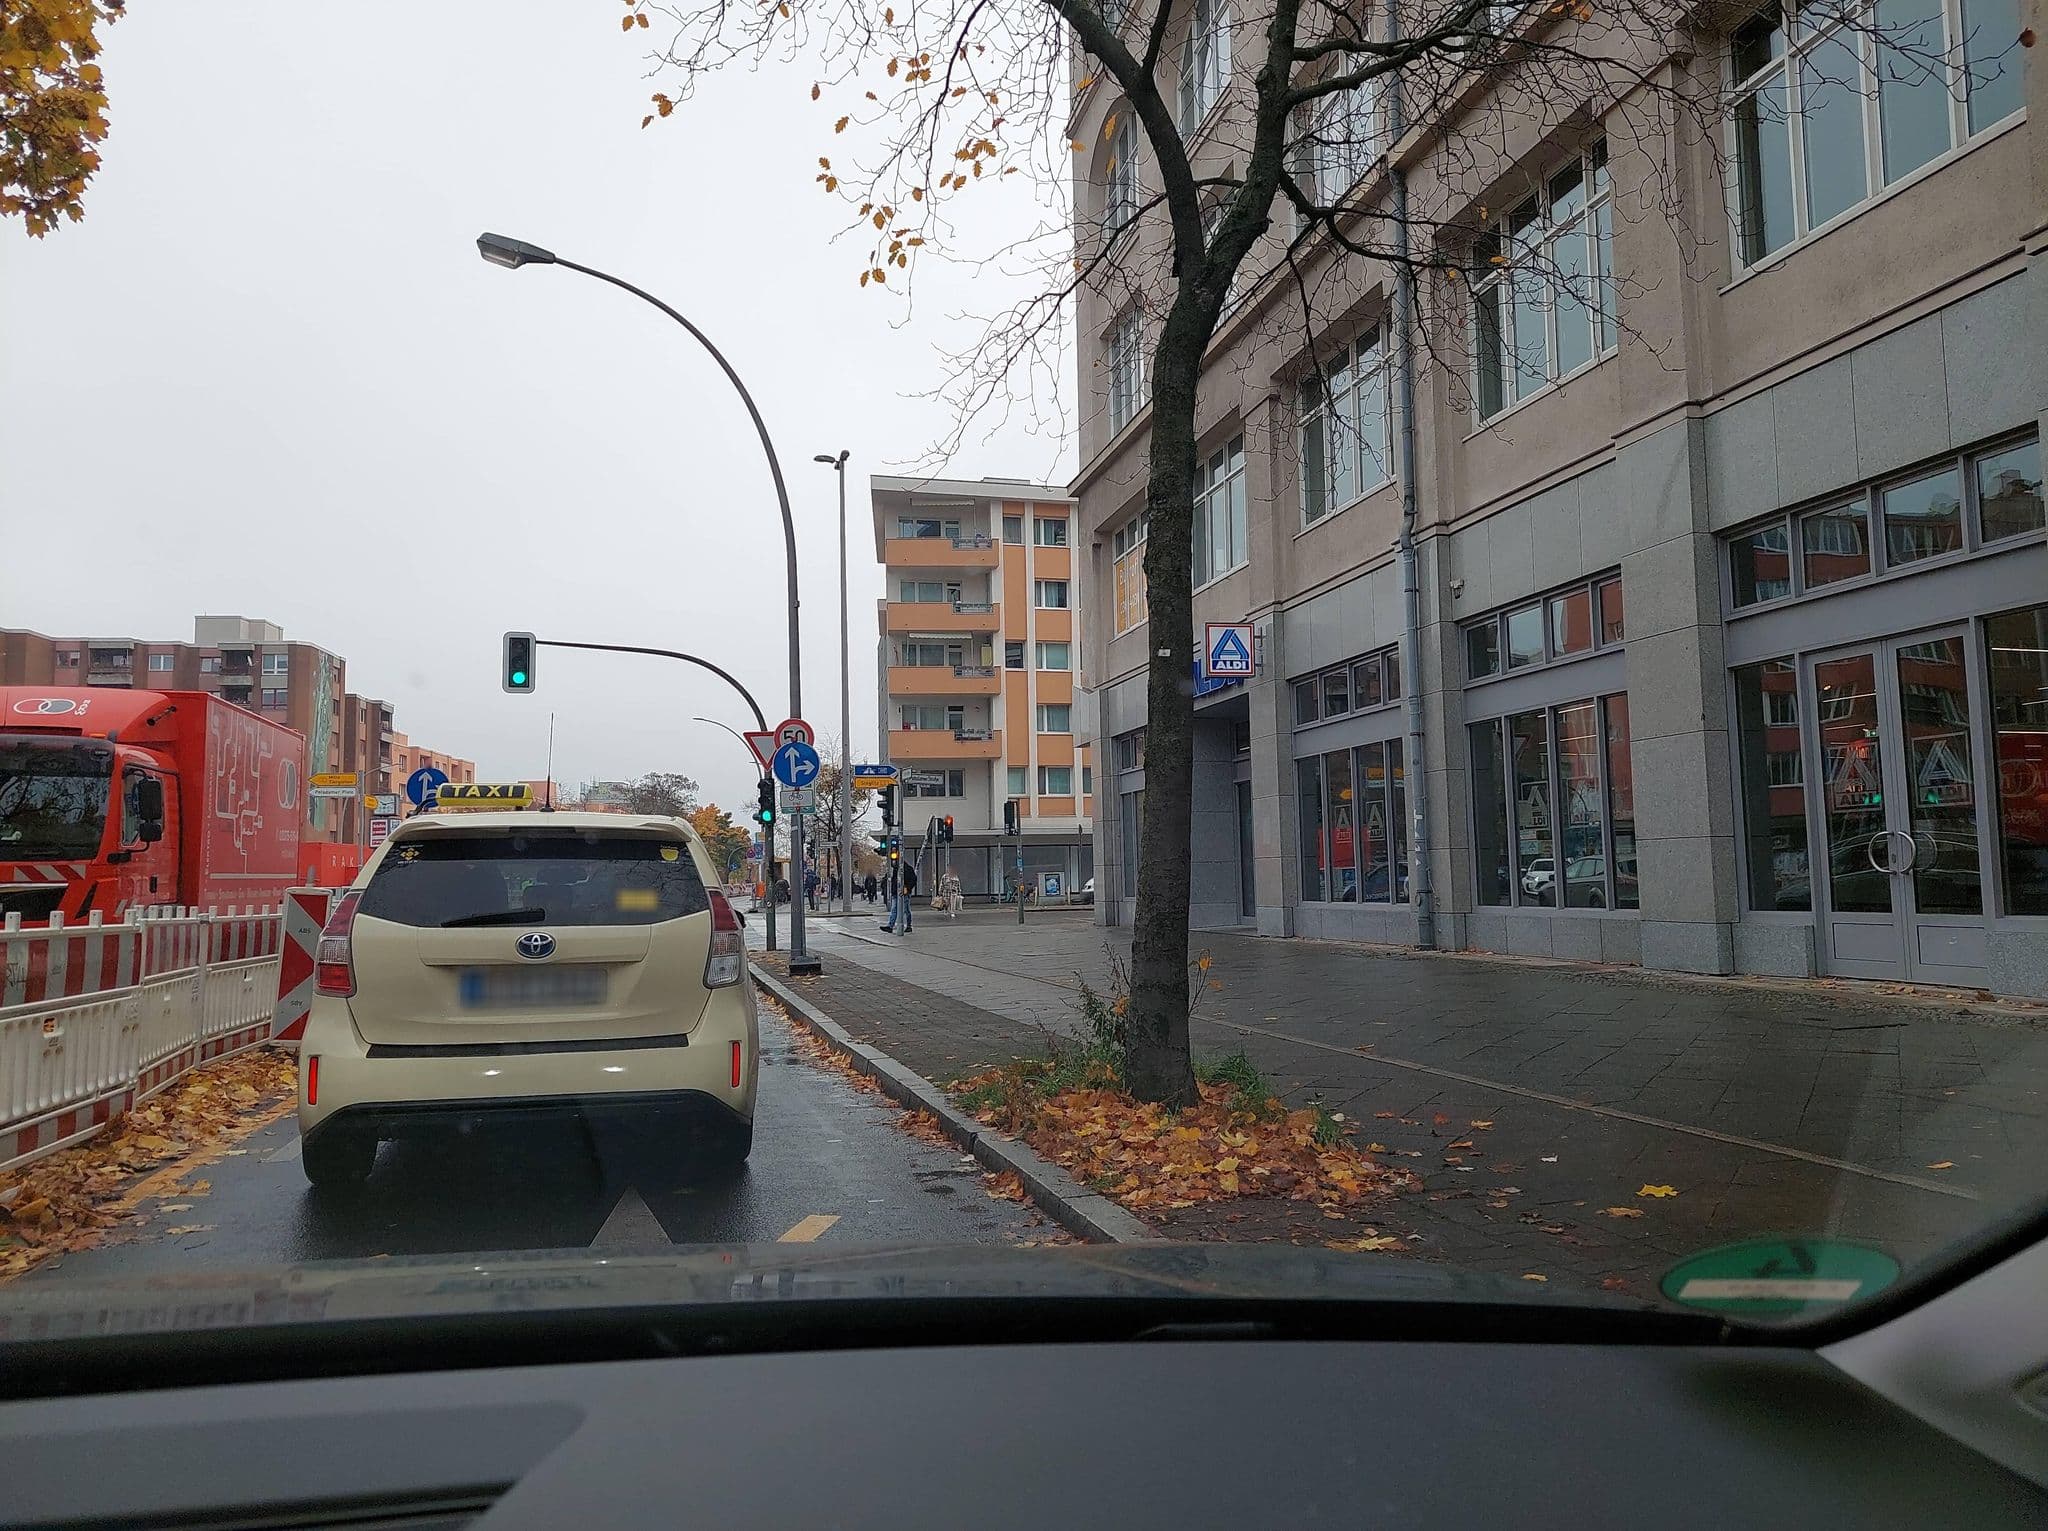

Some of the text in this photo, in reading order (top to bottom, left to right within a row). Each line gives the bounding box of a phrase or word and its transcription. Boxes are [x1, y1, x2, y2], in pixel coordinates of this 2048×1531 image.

[1216, 660, 1247, 670] ALDI
[783, 729, 806, 743] 50
[451, 785, 514, 798] TAXI
